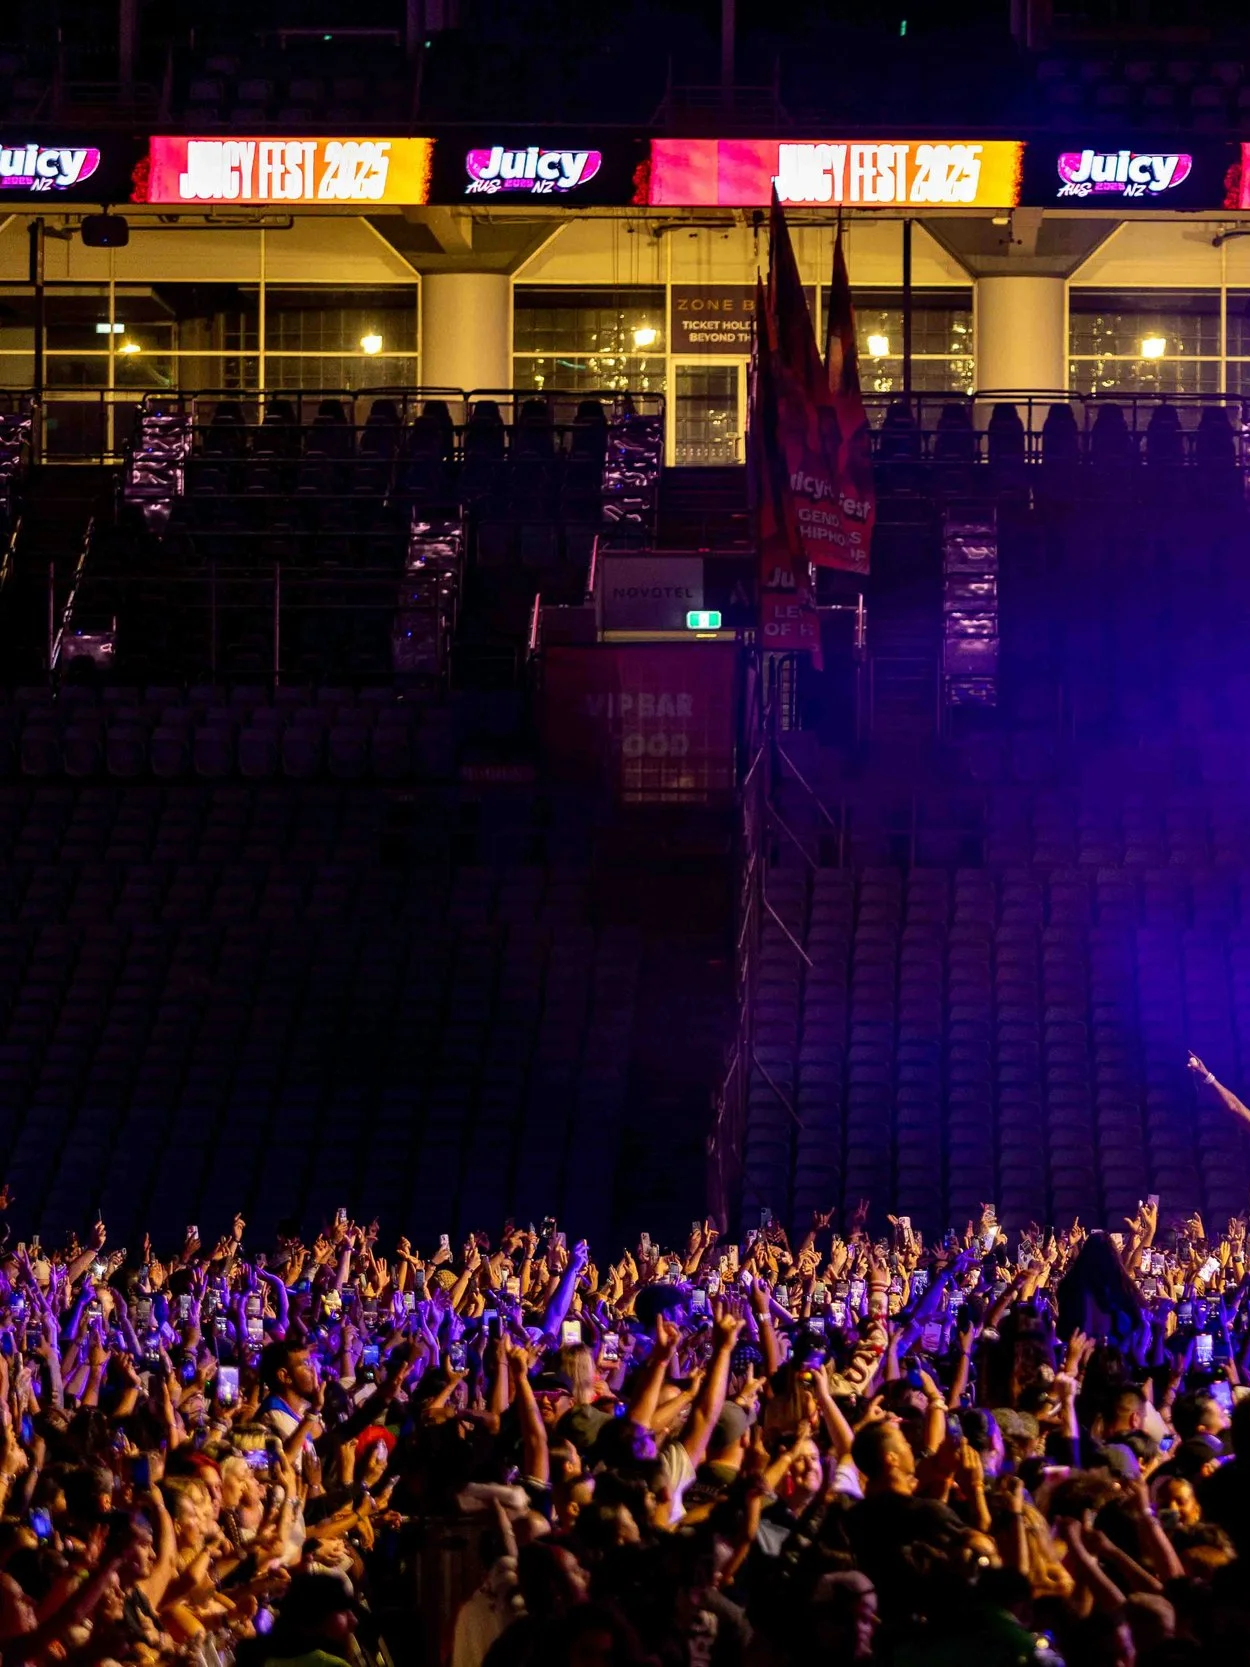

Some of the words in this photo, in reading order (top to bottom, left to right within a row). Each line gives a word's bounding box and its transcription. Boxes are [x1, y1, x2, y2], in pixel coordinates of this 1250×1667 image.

[0, 144, 88, 186] uicy
[180, 141, 256, 199] JUICY
[259, 141, 317, 200] FEST
[318, 141, 391, 200] 2025
[479, 146, 589, 188] Juicy
[1070, 150, 1179, 191] Juicy
[771, 144, 847, 202] JUICY
[851, 144, 909, 202] FEST
[910, 145, 983, 202] 2025
[30, 178, 53, 191] NZ
[465, 179, 501, 194] AUS
[531, 179, 554, 194] NZ
[1057, 183, 1092, 197] AUS
[1123, 183, 1146, 197] NZ
[678, 299, 734, 311] ZONE
[682, 320, 720, 330] TICKET
[689, 332, 735, 342] BEYOND
[613, 586, 693, 599] NOVOTEL
[763, 622, 792, 637] OF
[637, 692, 693, 718] BAR
[616, 733, 690, 757] OOD
